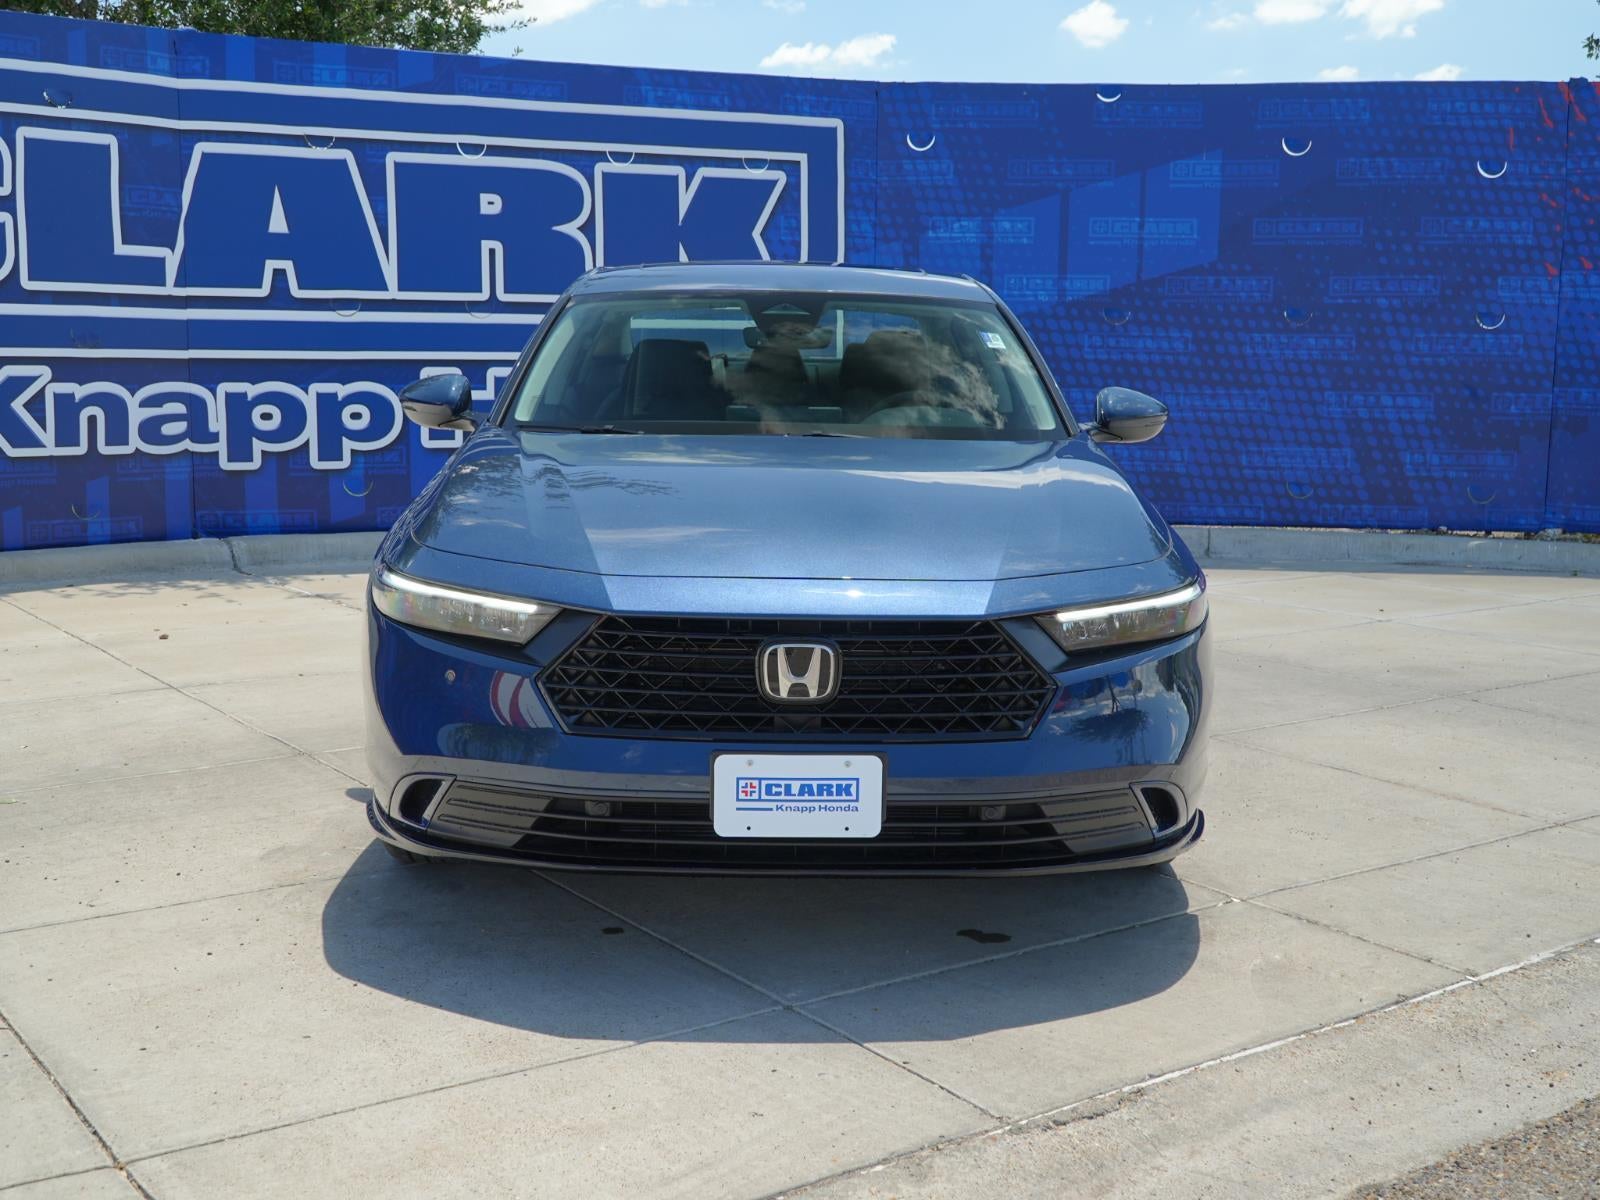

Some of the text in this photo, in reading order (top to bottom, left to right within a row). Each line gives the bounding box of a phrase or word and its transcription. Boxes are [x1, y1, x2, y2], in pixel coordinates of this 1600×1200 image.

[0, 126, 788, 302] LARK
[764, 783, 853, 797] CLARK
[775, 804, 859, 814] Knapp Honda
